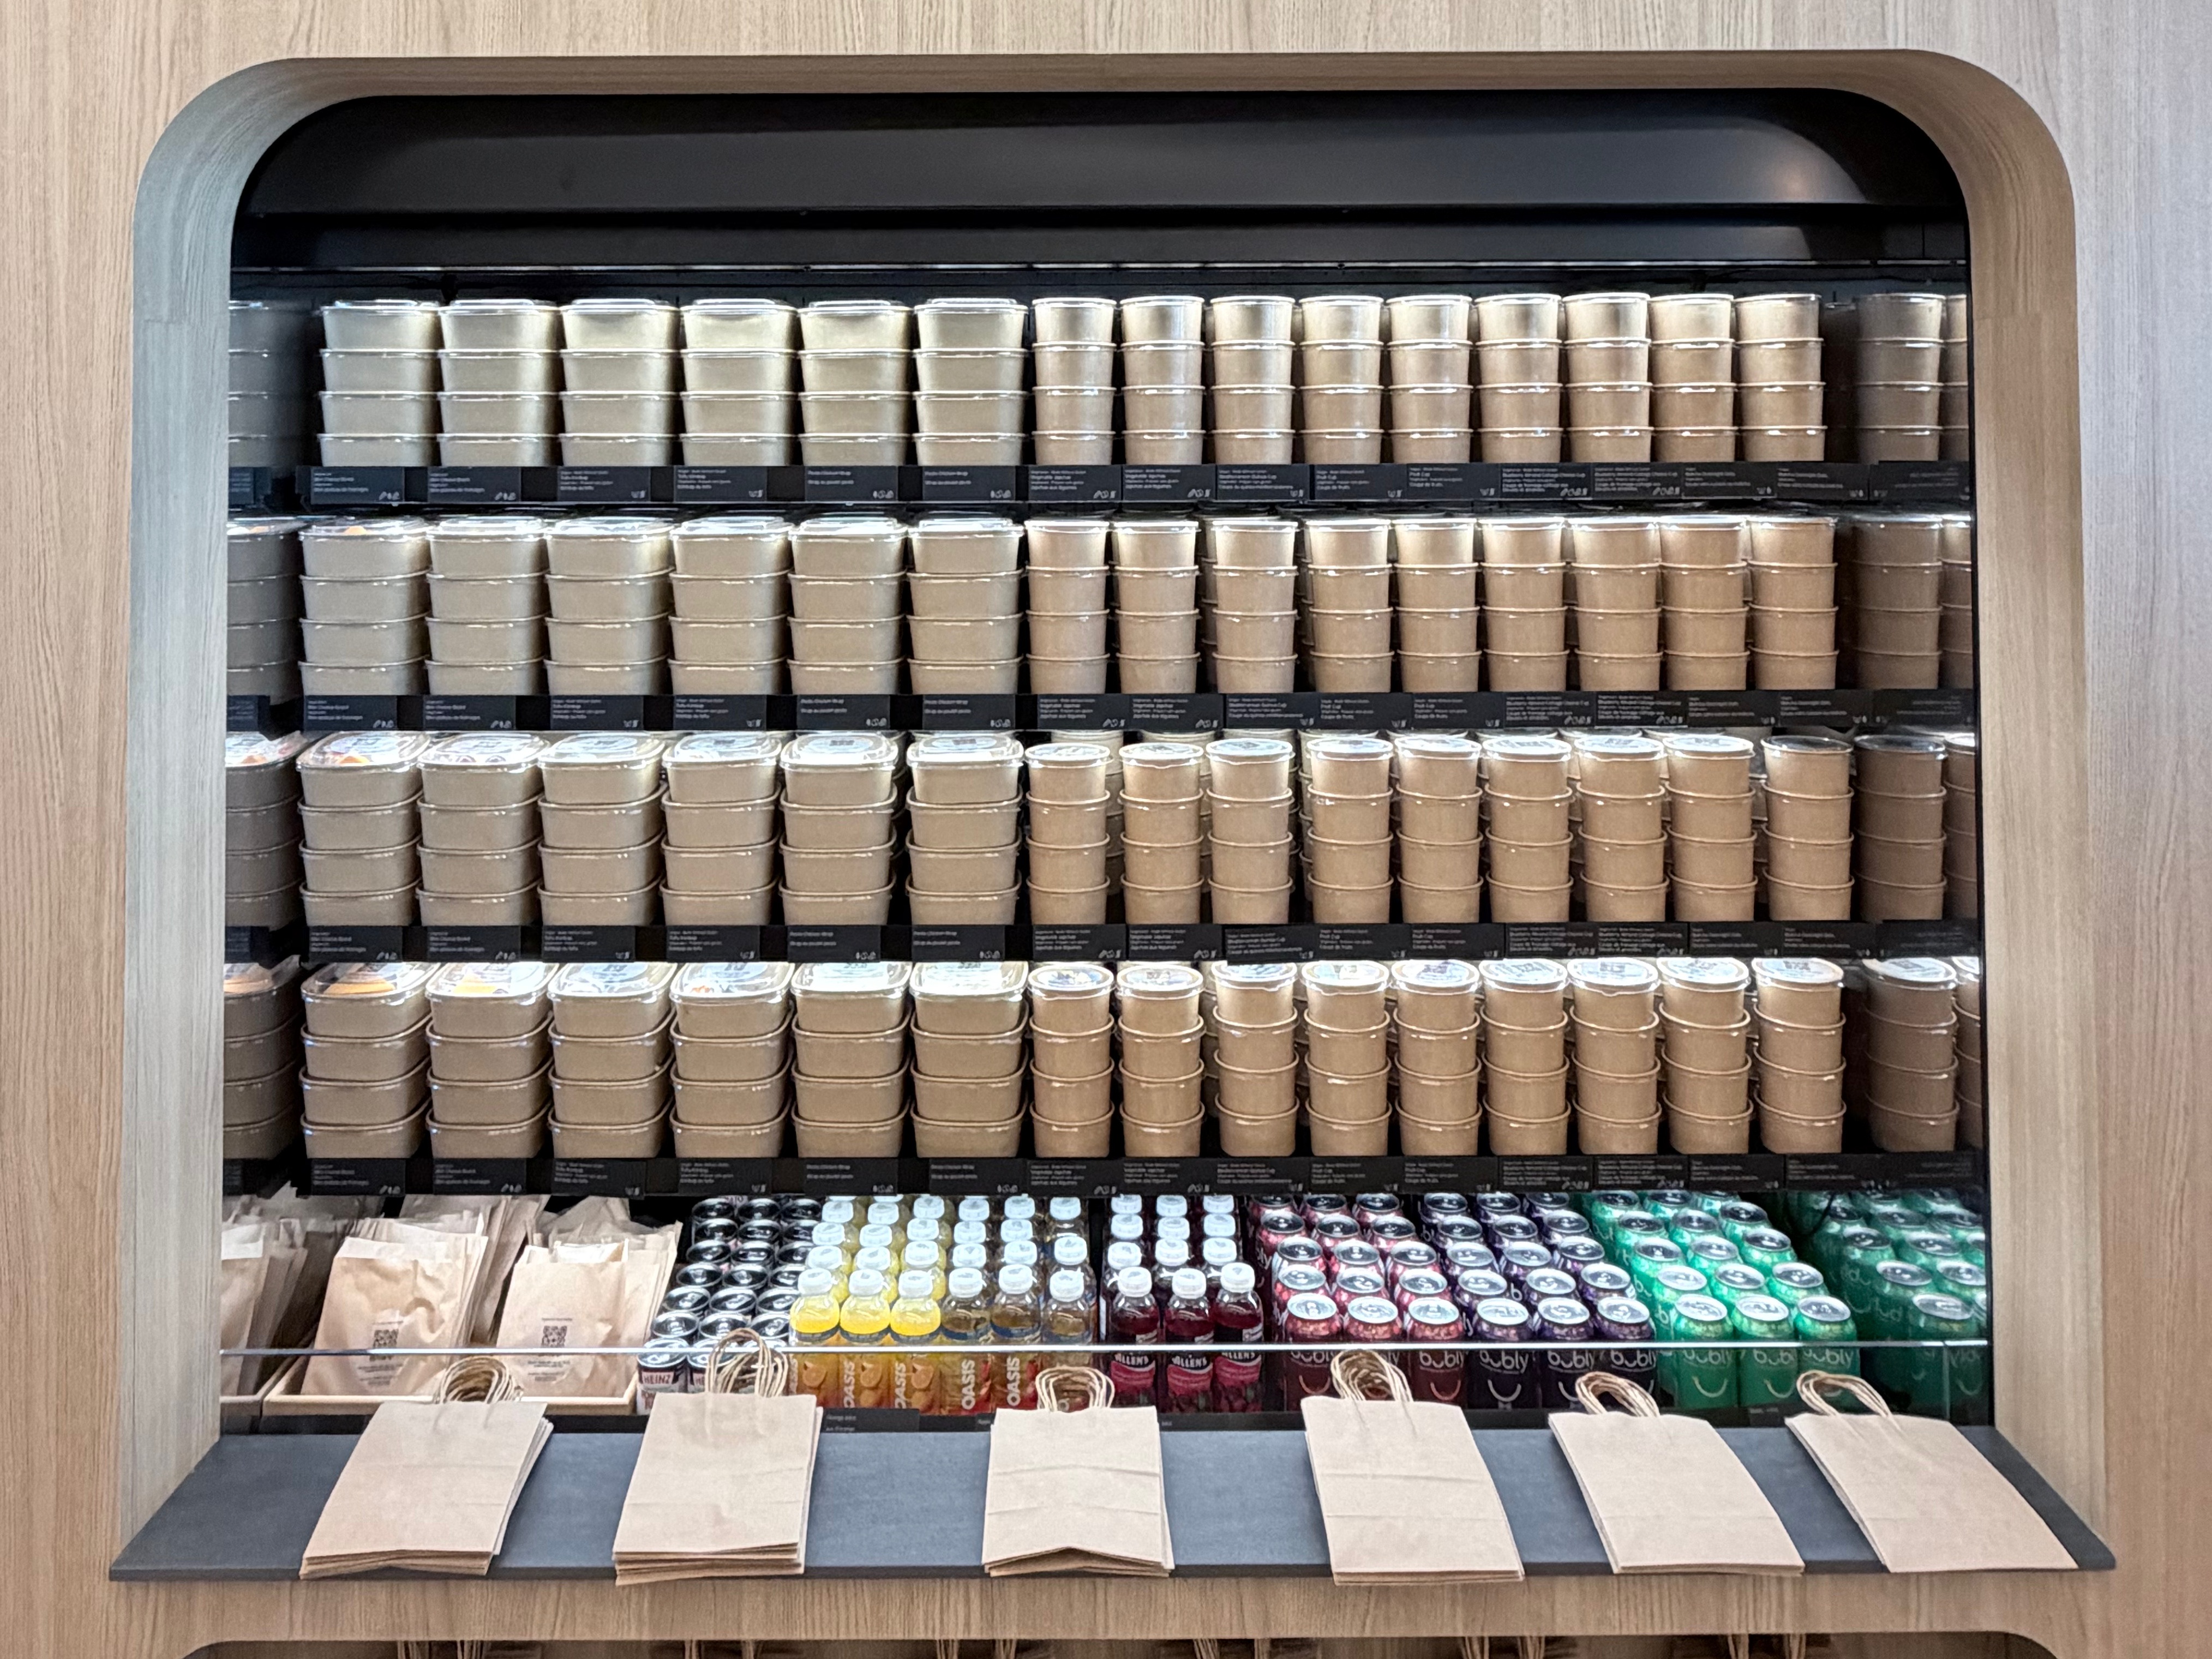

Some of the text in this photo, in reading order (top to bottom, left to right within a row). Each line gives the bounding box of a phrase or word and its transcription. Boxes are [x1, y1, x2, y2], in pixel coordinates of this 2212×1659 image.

[644, 1374, 670, 1384] HEINZ
[962, 1360, 975, 1409] OASIS
[1007, 1356, 1020, 1406] OASIS
